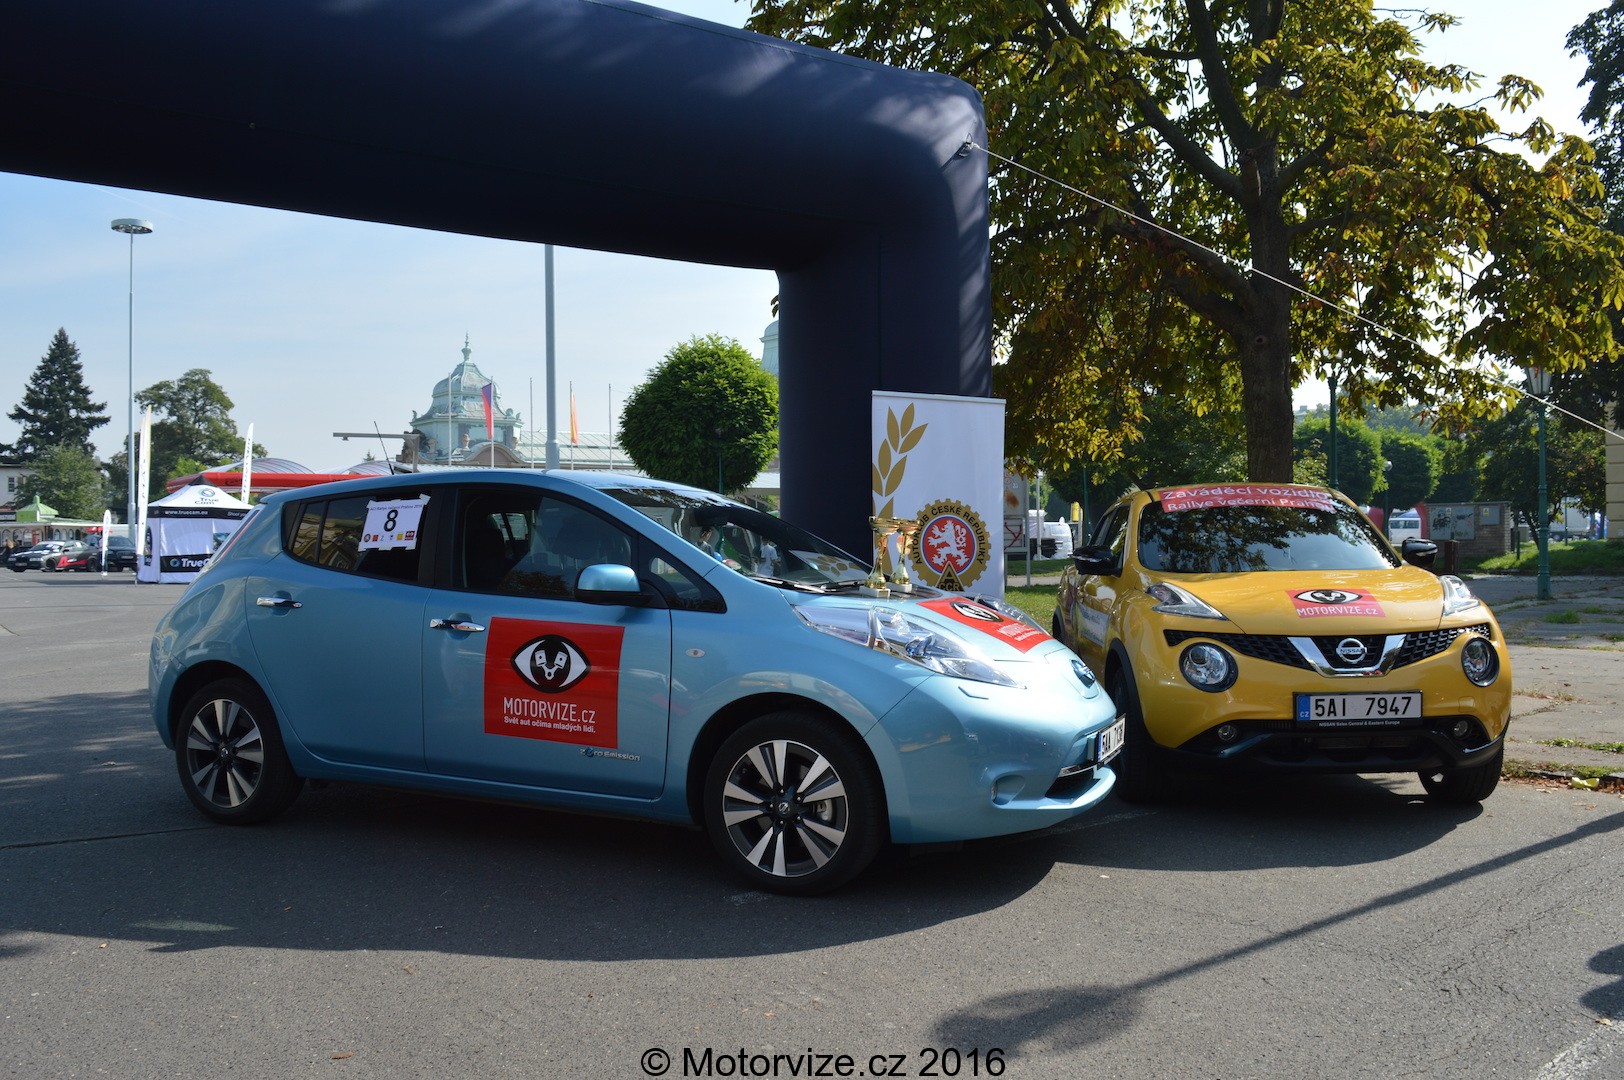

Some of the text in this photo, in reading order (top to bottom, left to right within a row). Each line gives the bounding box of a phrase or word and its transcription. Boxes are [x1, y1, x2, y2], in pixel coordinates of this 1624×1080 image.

[1256, 488, 1328, 500] vozidlo
[1167, 500, 1214, 511] Rallye
[384, 509, 398, 532] 8
[962, 511, 986, 564] REPUBLIKY
[1315, 696, 1412, 717] 5AI 7947
[503, 716, 519, 725] Svět
[531, 720, 552, 729] očima
[553, 721, 582, 732] mladých
